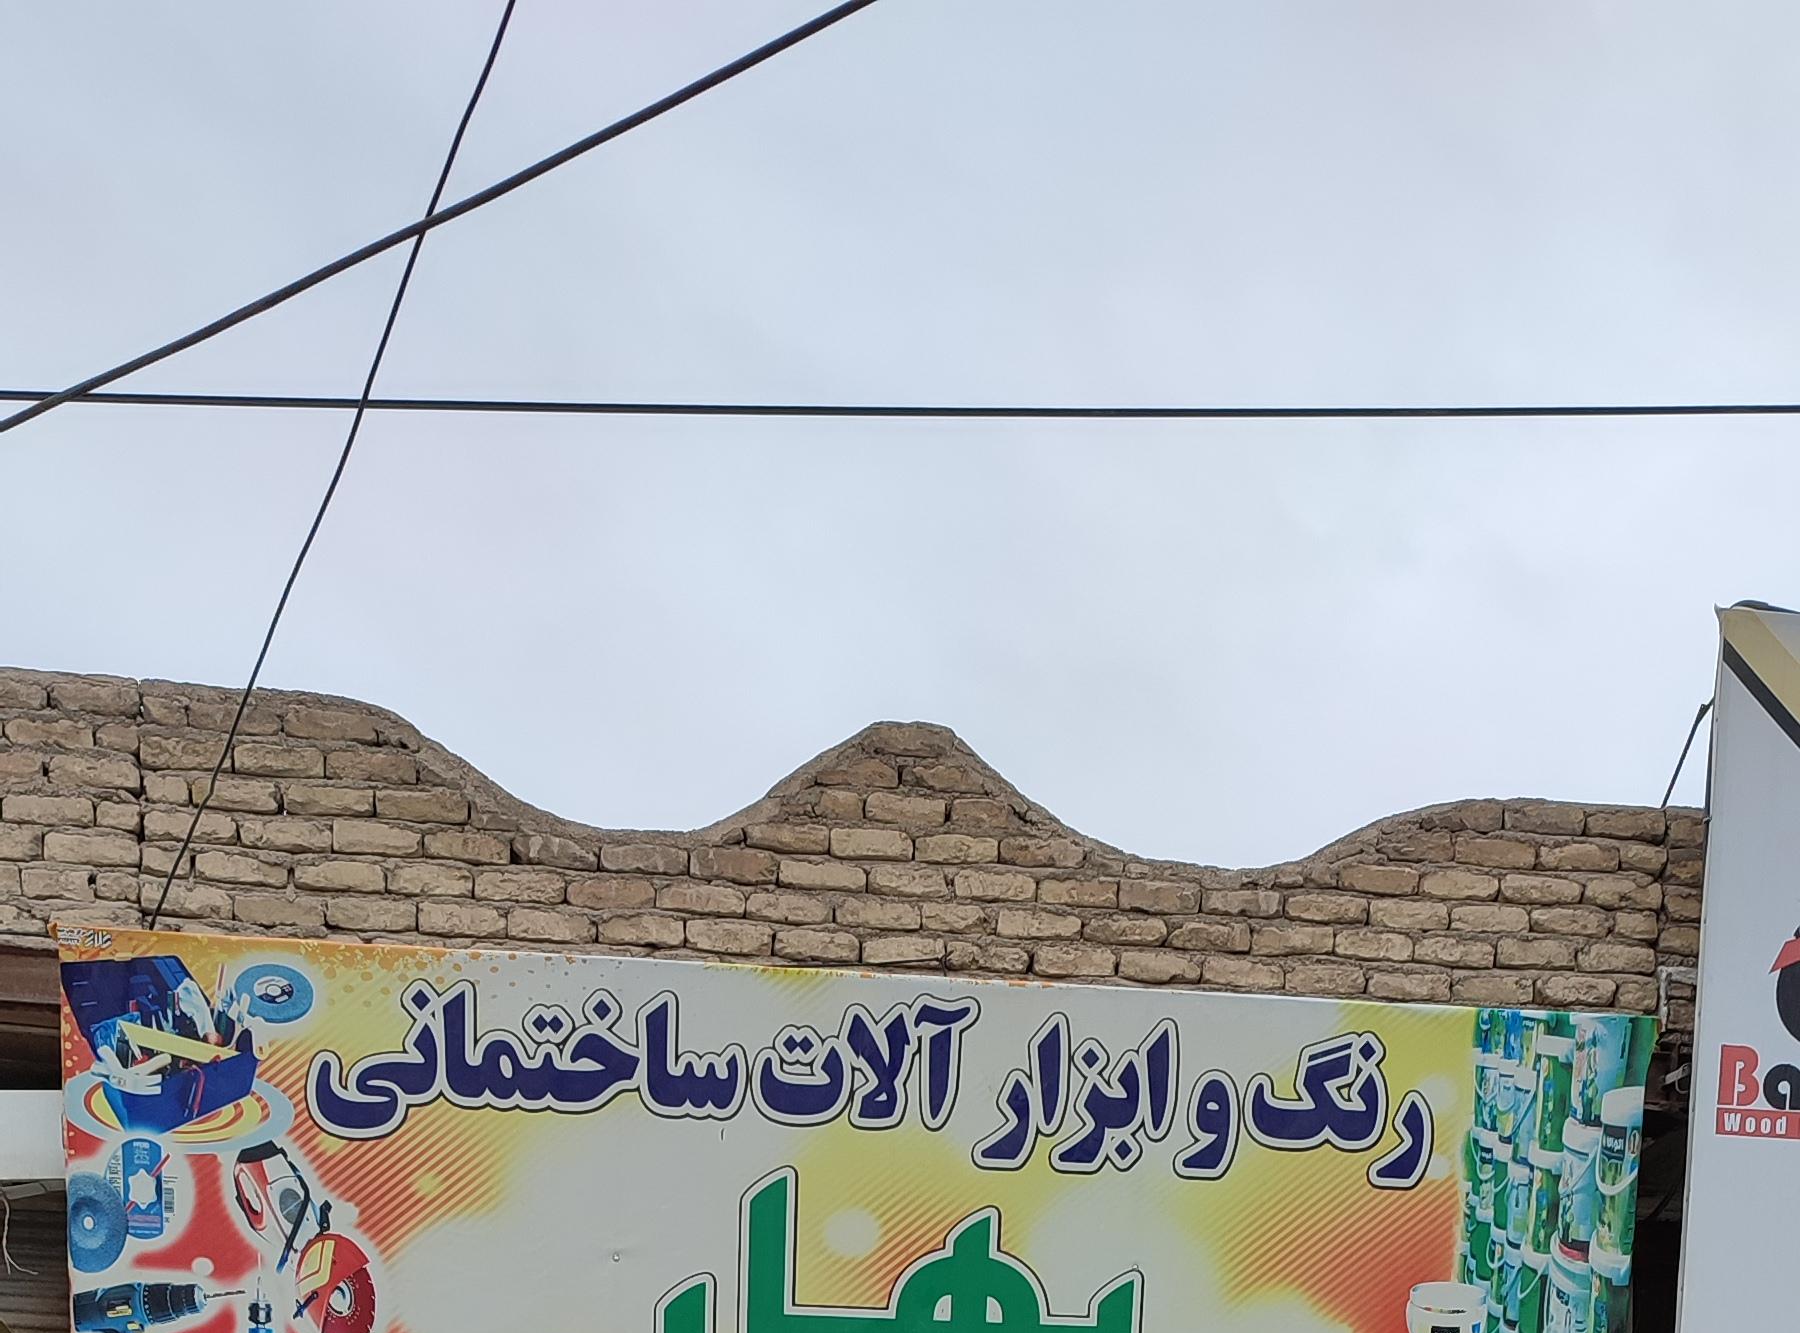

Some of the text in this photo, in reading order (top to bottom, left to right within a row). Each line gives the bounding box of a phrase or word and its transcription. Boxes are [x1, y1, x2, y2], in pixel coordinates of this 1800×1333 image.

[311, 984, 1430, 1184] رنگ و ابزار آلات ساختمانی
[1723, 1111, 1787, 1136] Wood
